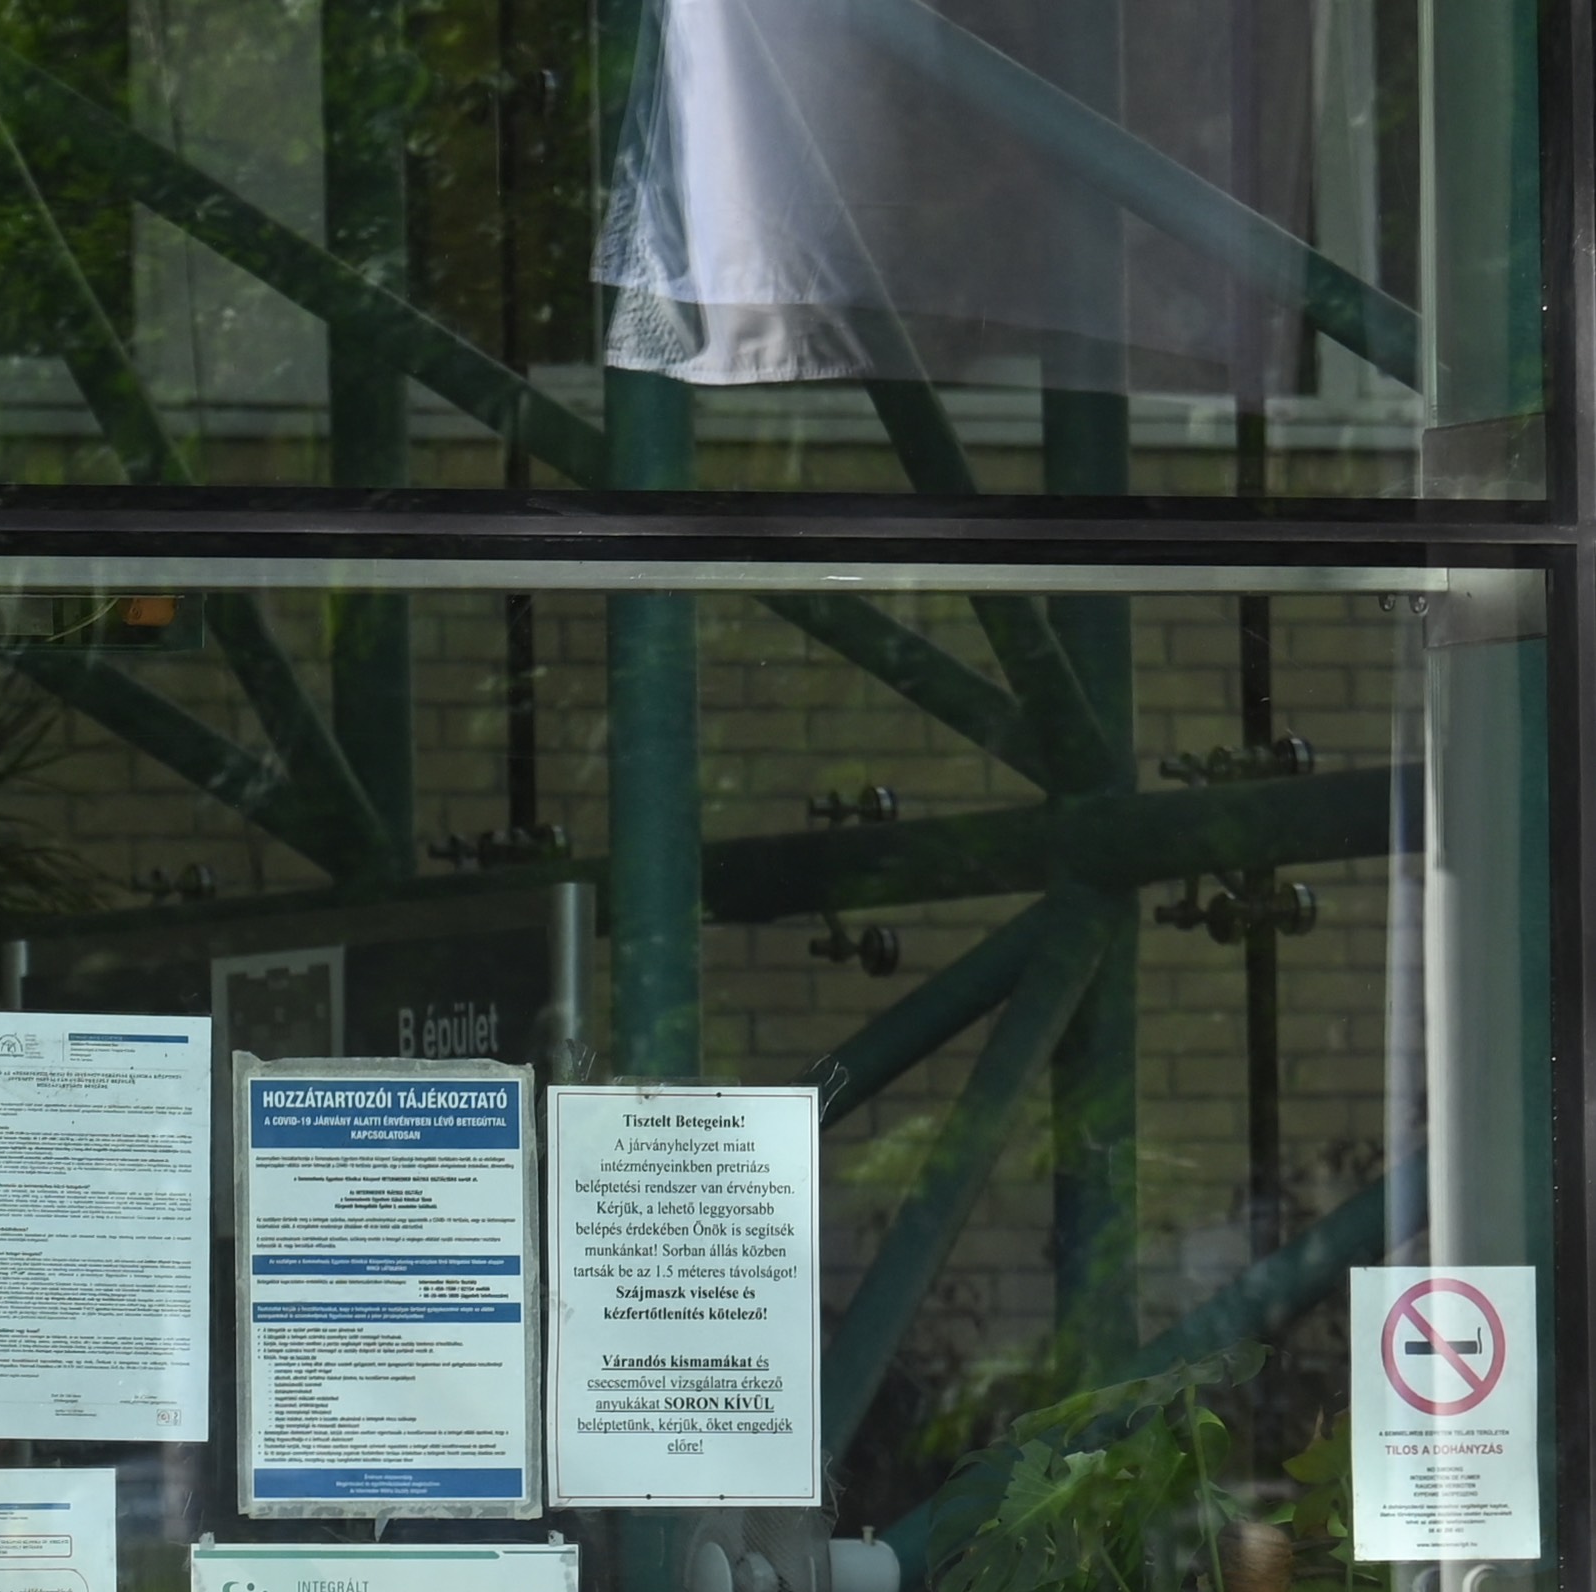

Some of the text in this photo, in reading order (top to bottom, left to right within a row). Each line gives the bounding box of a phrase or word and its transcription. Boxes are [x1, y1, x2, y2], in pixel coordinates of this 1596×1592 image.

[399, 1002, 498, 1057] B épület
[263, 1086, 508, 1109] HOZZÁTARTOZÓI TÁJÉKOZTATÓ
[264, 1116, 271, 1126] A
[271, 1115, 311, 1127] COVID-19
[312, 1115, 352, 1127] JÁRVÁNY
[353, 1116, 382, 1126] ALATTI
[383, 1115, 432, 1127] ÉRVÉNYBEN
[456, 1115, 507, 1127] BETEGÚTTAL
[622, 1114, 745, 1132] Tisztelt Betegeink!
[350, 1130, 421, 1140] KAPCSOLATOSAN
[614, 1137, 756, 1156] A járványhelyzet miatt
[600, 1158, 771, 1177] intézményeinkben pretriázs
[575, 1178, 795, 1198] beléptetési rendszer van érvényben.
[596, 1200, 775, 1219] Kérjük, a lehető leggyorsabb
[575, 1219, 795, 1240] belépés érdekében Önök is segítsék
[584, 1242, 787, 1258] munkánkat! Sorban állás közben
[573, 1263, 797, 1282] tartsák be az 1.5 méteres távolságot!
[615, 1285, 756, 1303] Szájmaszk viselése és
[603, 1306, 768, 1321] kézfertőtlenítés kötelező!
[602, 1354, 770, 1368] Várandós kismamákat és
[586, 1375, 783, 1390] csecsemővel vizsgálatra érkező
[595, 1393, 775, 1411] anyukákat SORON KÍVÜL
[577, 1417, 793, 1432] beléptetünk, kérjük, őket engedjék
[667, 1438, 703, 1452] előre!
[1384, 1443, 1505, 1456] TILOS A DOHÁNYZÁS
